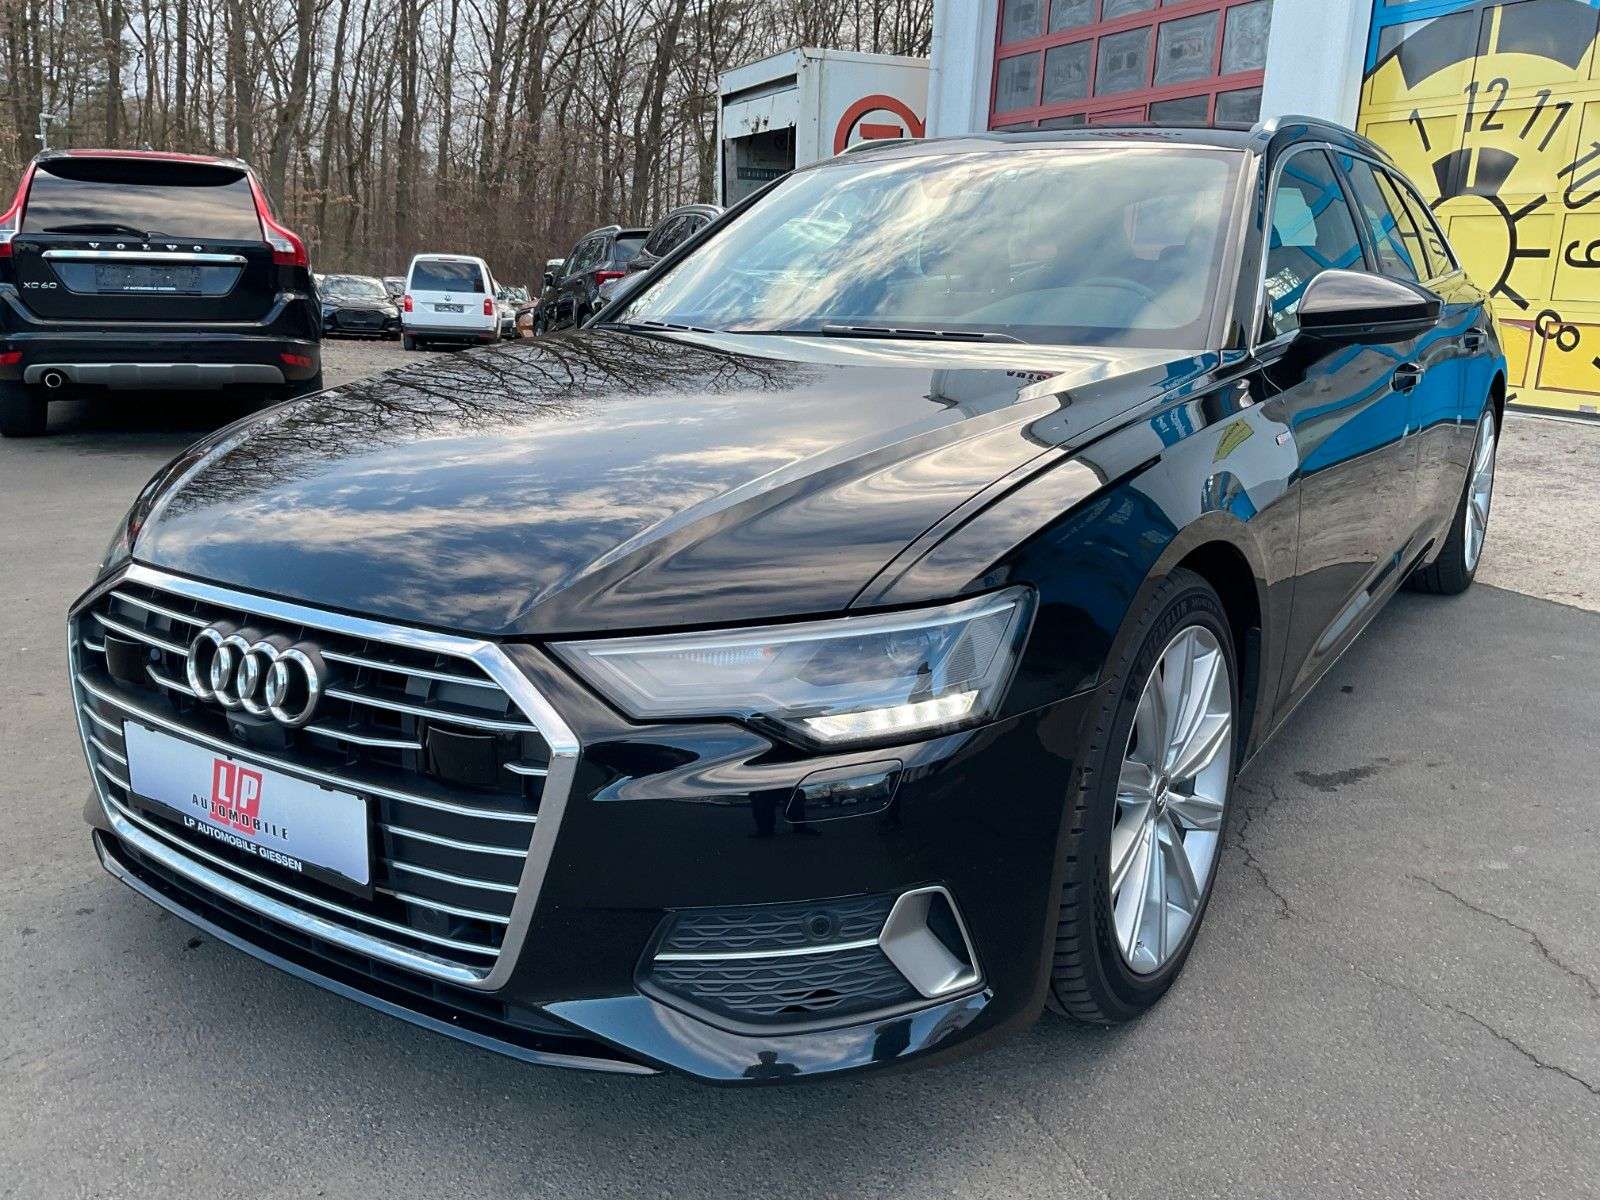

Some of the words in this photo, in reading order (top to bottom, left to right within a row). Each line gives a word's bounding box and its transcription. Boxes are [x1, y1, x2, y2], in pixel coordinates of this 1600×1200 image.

[1464, 77, 1509, 132] 12
[1519, 89, 1573, 152] 11
[1408, 108, 1431, 152] 1
[88, 242, 203, 251] VOLVO
[1535, 308, 1580, 352] 8
[218, 766, 259, 809] LP
[192, 793, 289, 840] AUTOMOBILE
[184, 815, 196, 827] LP
[198, 822, 257, 854] AUTOMOBILE
[259, 847, 303, 872] GIESSEN
